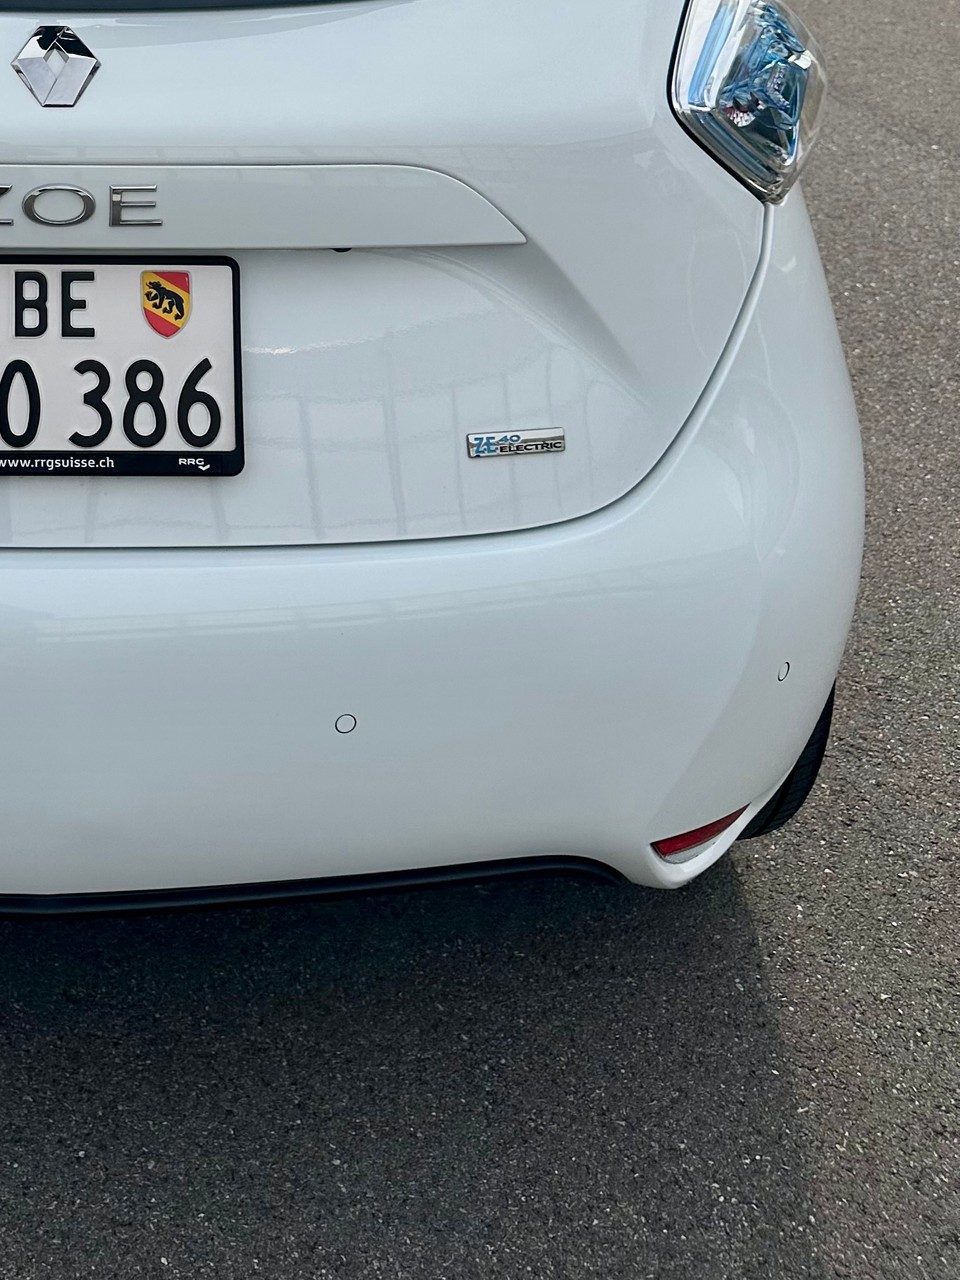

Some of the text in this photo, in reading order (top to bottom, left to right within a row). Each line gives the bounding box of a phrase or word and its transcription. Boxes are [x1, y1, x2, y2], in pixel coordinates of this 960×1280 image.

[14, 271, 96, 338] BE
[68, 357, 222, 449] 386
[178, 458, 205, 466] RRG
[500, 441, 563, 453] ELECTRIC
